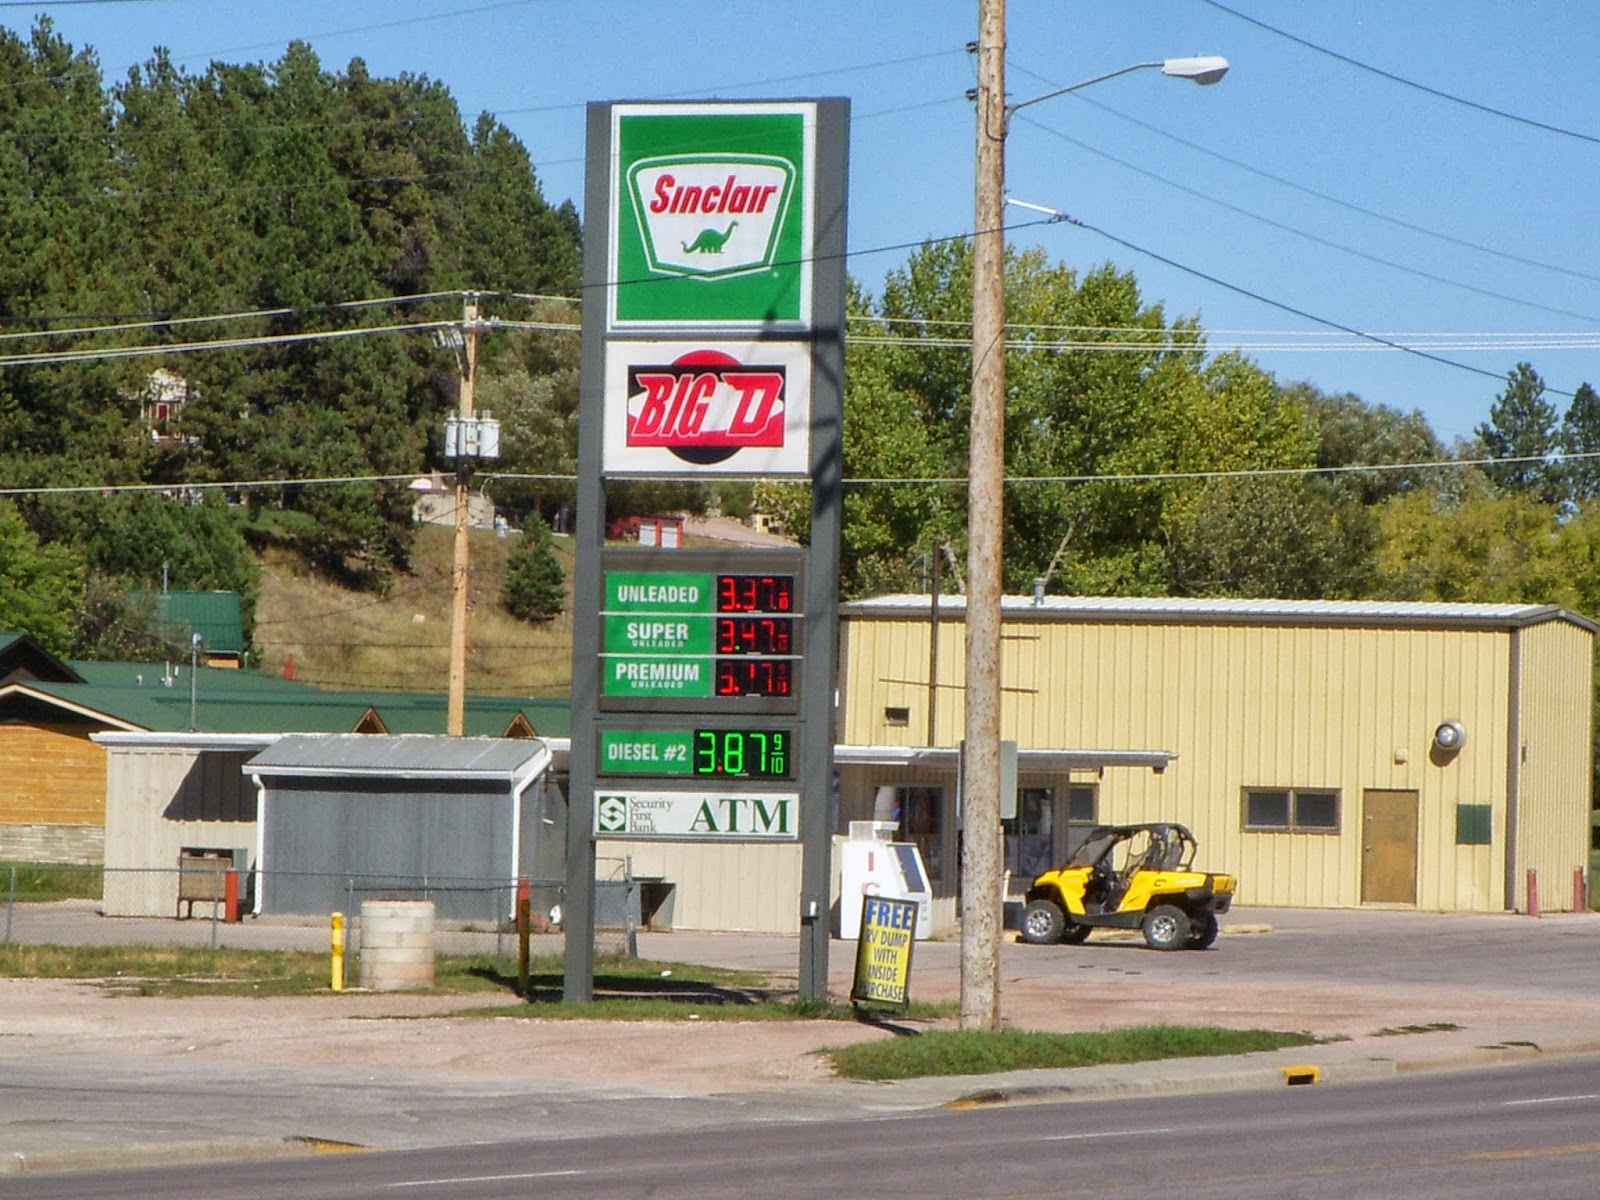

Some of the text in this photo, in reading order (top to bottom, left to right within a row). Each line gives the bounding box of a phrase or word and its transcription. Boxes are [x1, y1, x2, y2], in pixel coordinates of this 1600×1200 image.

[650, 174, 777, 214] Sinclair
[631, 373, 784, 438] BIG D
[618, 585, 699, 603] UNLEADED
[627, 623, 689, 640] SUPER
[631, 639, 684, 648] UNLEADED
[615, 663, 700, 681] PREMIUM
[631, 680, 684, 689] UNLEADED
[608, 744, 687, 761] DIESEL #2
[630, 796, 673, 812] Security
[630, 809, 652, 821] First
[688, 799, 792, 833] ATM
[630, 819, 657, 833] Bank
[865, 900, 912, 930] FREE
[881, 930, 908, 948] DUMP
[873, 948, 898, 965] WITH
[867, 964, 898, 982] INSIDE
